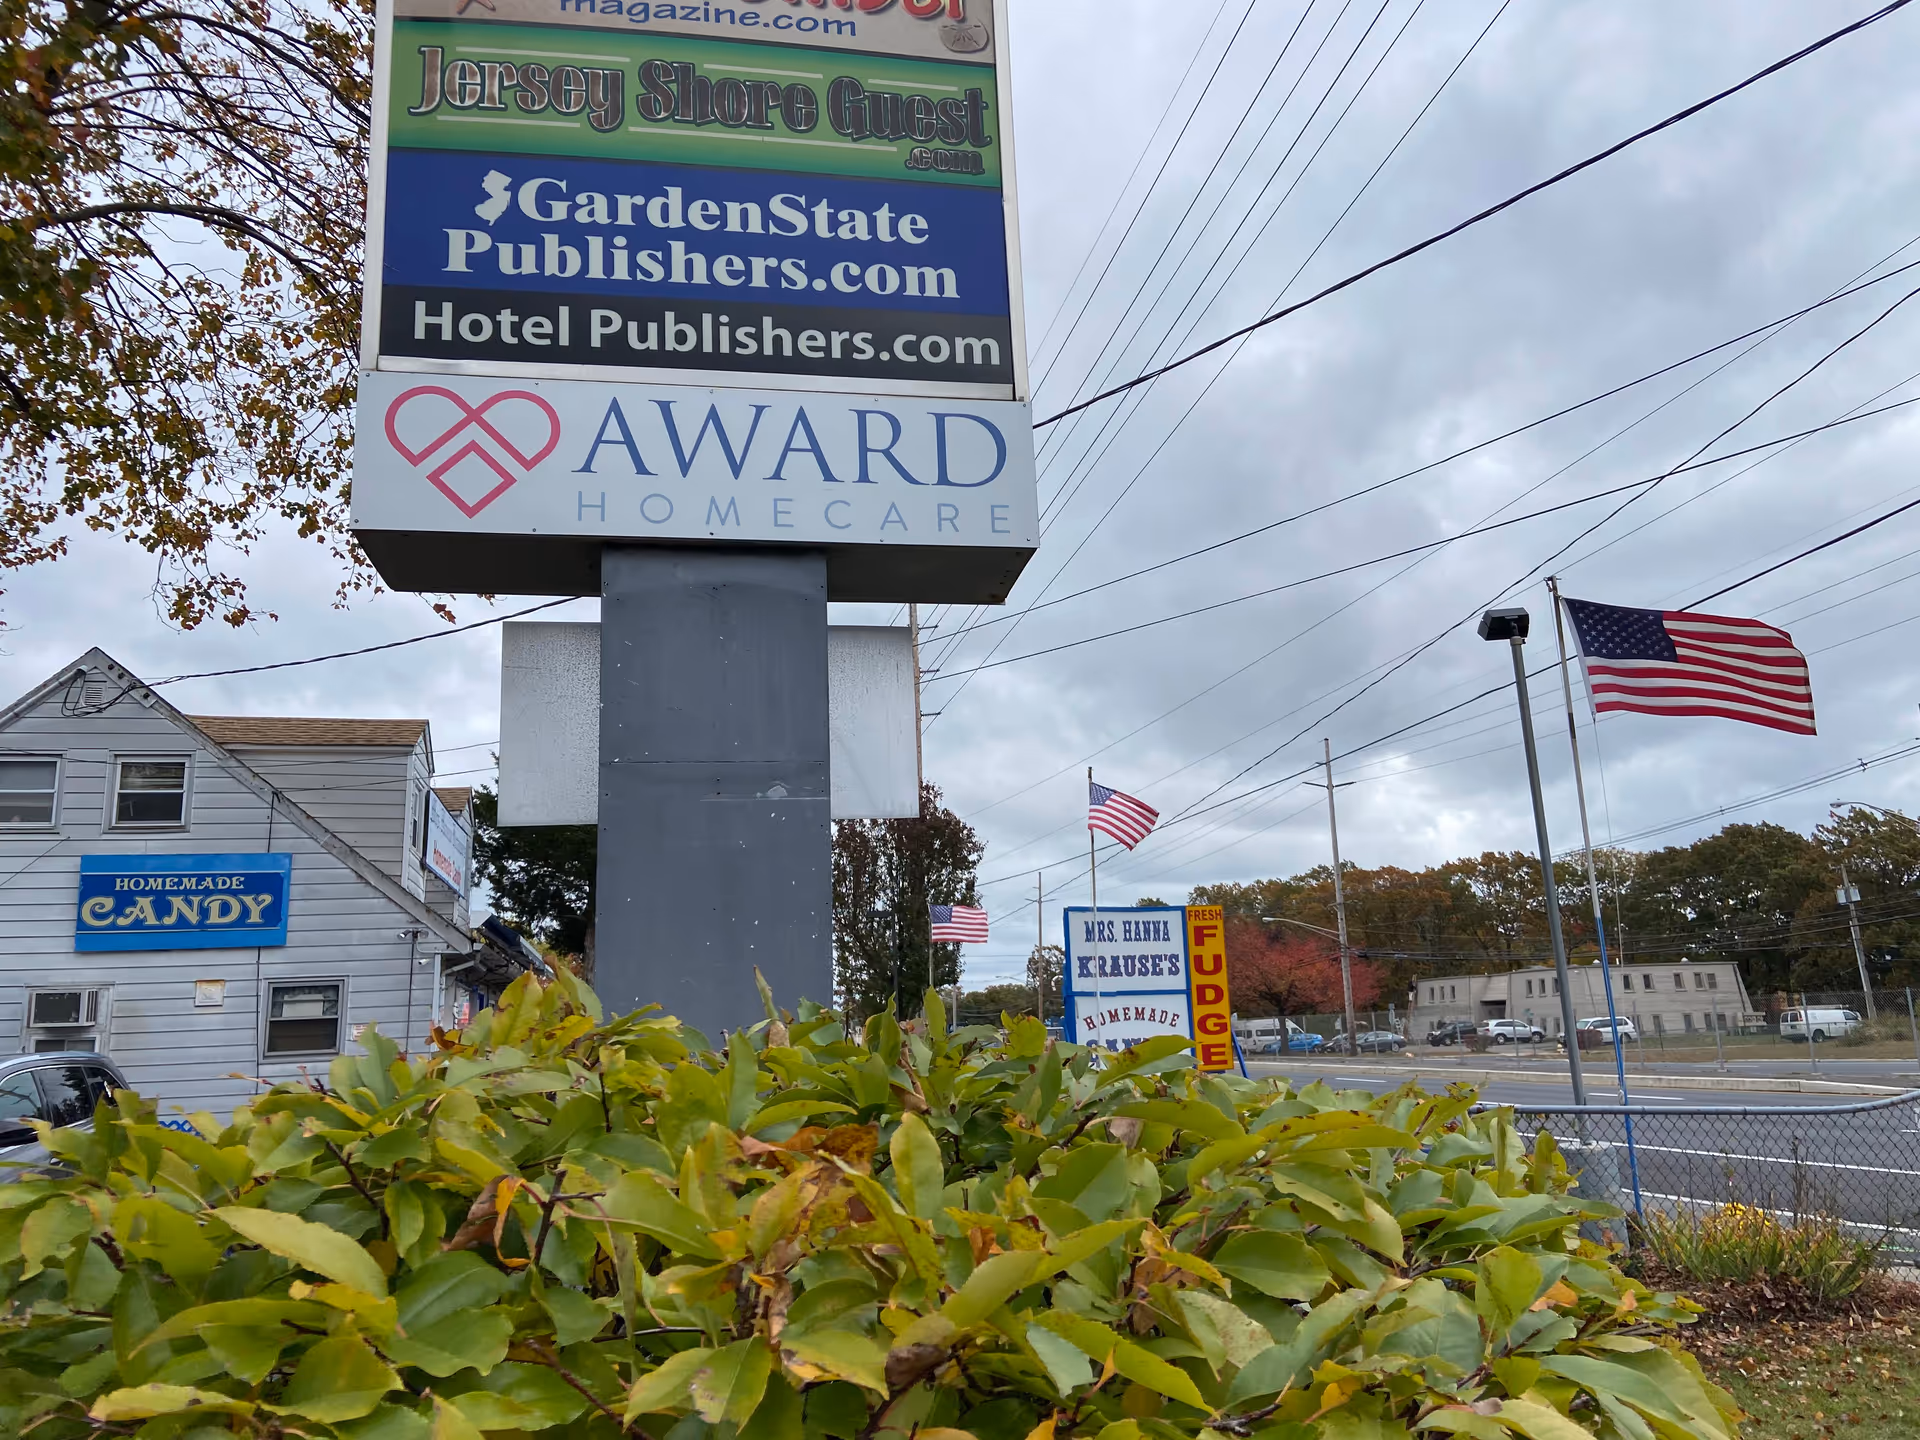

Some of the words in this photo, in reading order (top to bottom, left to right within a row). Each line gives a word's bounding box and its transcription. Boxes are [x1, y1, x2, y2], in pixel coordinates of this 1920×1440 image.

[560, 0, 857, 36] magazine.com
[408, 46, 624, 133] Jersey
[636, 59, 819, 133] Shore
[827, 76, 993, 147] Guest
[905, 147, 986, 176] .com
[517, 177, 929, 244] GardenState
[441, 227, 961, 299] Publishers.com
[413, 300, 571, 347] Hotel
[590, 307, 1000, 366] Publishers.com
[571, 396, 1007, 488] AWARD
[577, 490, 1012, 534] HOMECARE
[114, 876, 245, 891] HOMEMADE
[80, 894, 274, 927] CANDY
[1187, 909, 1222, 922] FRESH
[1084, 920, 1118, 943] MRS.
[1122, 920, 1171, 942] HANNA
[1077, 954, 1181, 978] KRAUSE'S
[1193, 924, 1228, 1066] FUDGE
